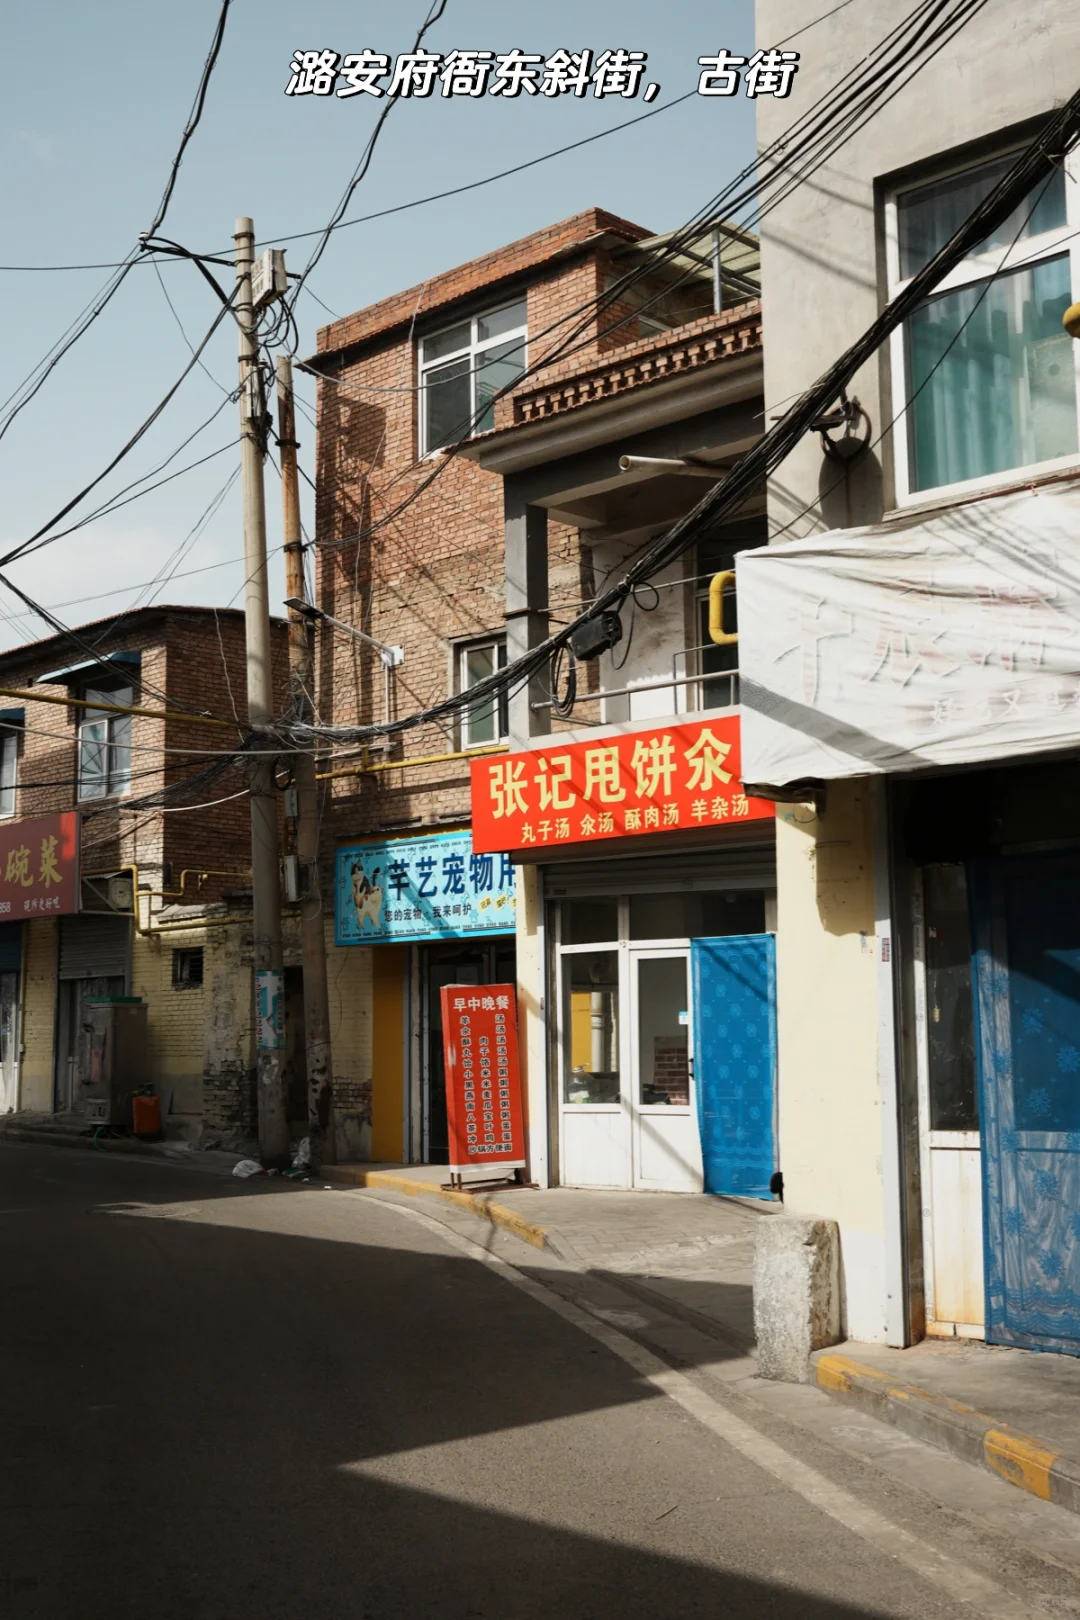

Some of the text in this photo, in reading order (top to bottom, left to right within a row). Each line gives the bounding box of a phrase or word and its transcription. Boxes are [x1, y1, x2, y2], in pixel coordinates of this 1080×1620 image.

[520, 817, 571, 845] 丸子汤
[624, 803, 680, 831] 酥肉汤
[690, 793, 750, 823] 羊杂汤
[0, 835, 64, 889] 碗菜
[384, 903, 473, 922] 您的宠物 我来呵护
[453, 995, 510, 1012] 早中晚餐
